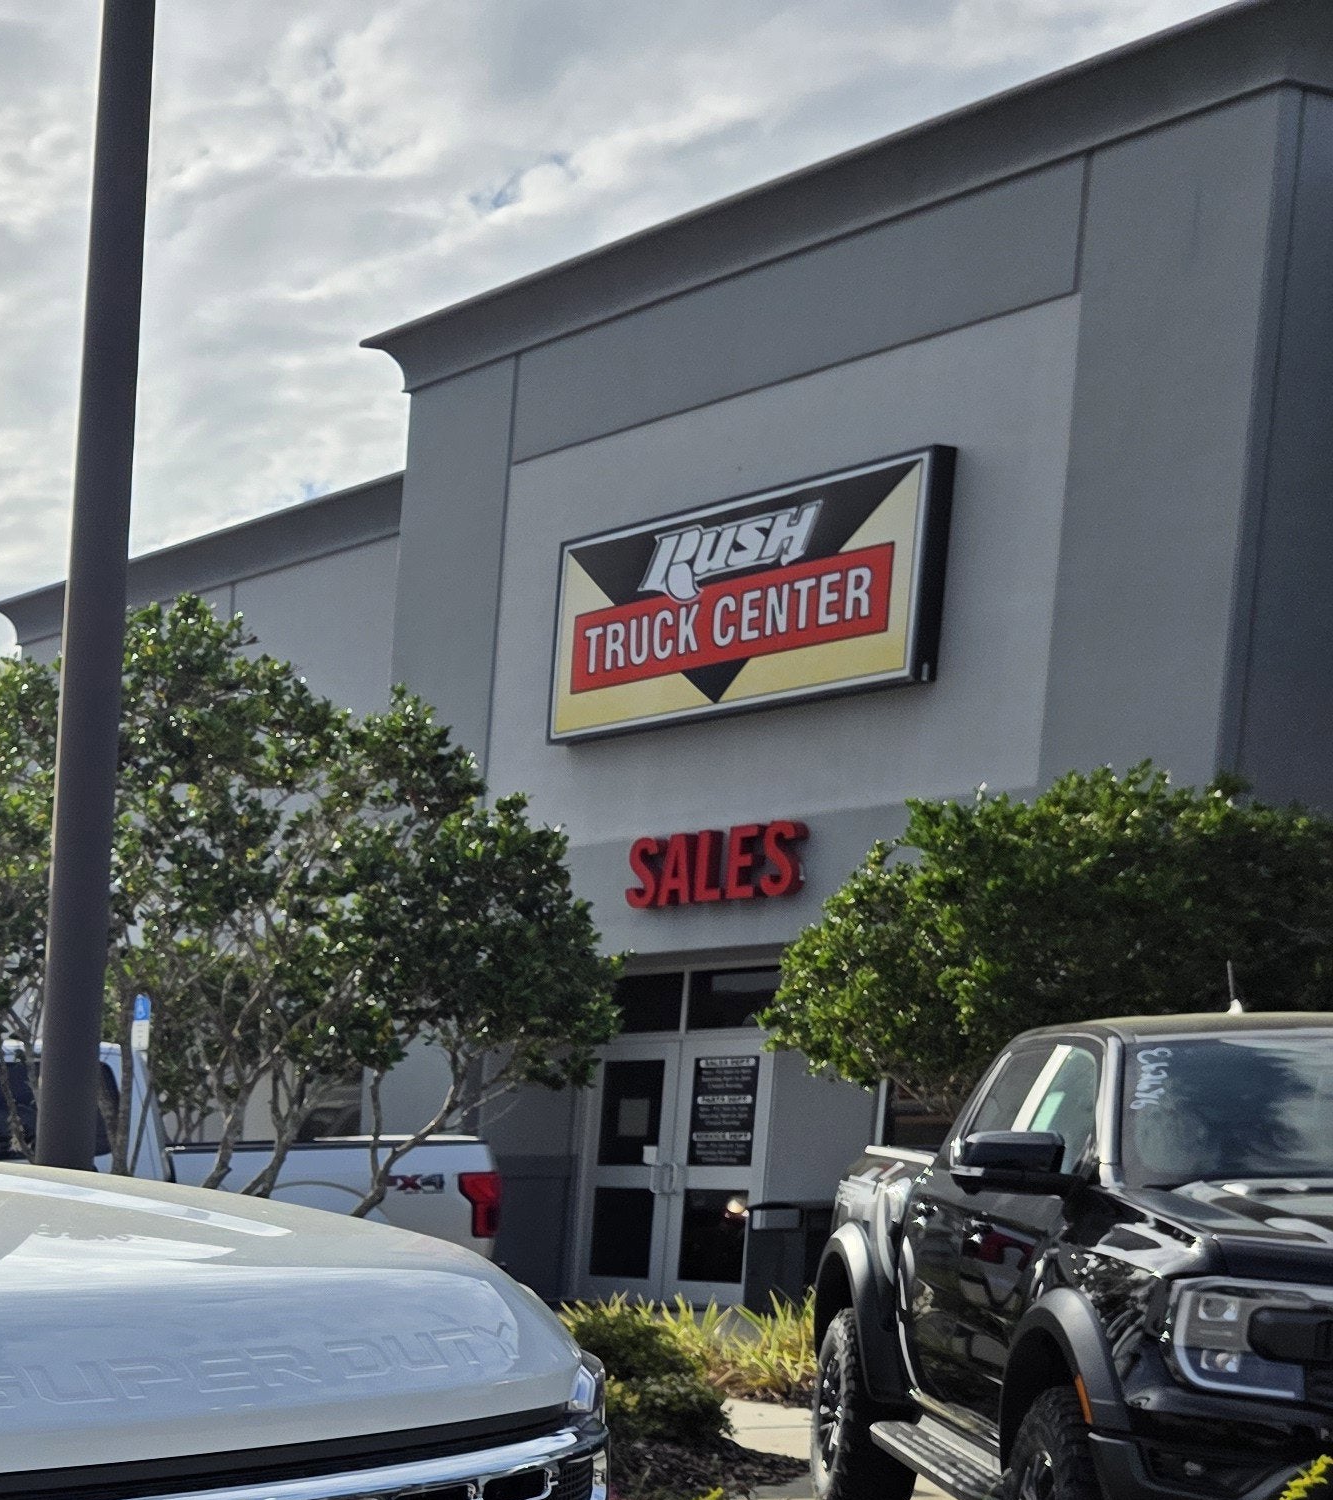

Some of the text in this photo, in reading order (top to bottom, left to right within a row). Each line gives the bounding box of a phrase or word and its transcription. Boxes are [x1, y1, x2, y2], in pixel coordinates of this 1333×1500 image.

[585, 566, 872, 673] TRUCK CENTER
[625, 818, 808, 909] SALES
[324, 1320, 521, 1380] DUTY
